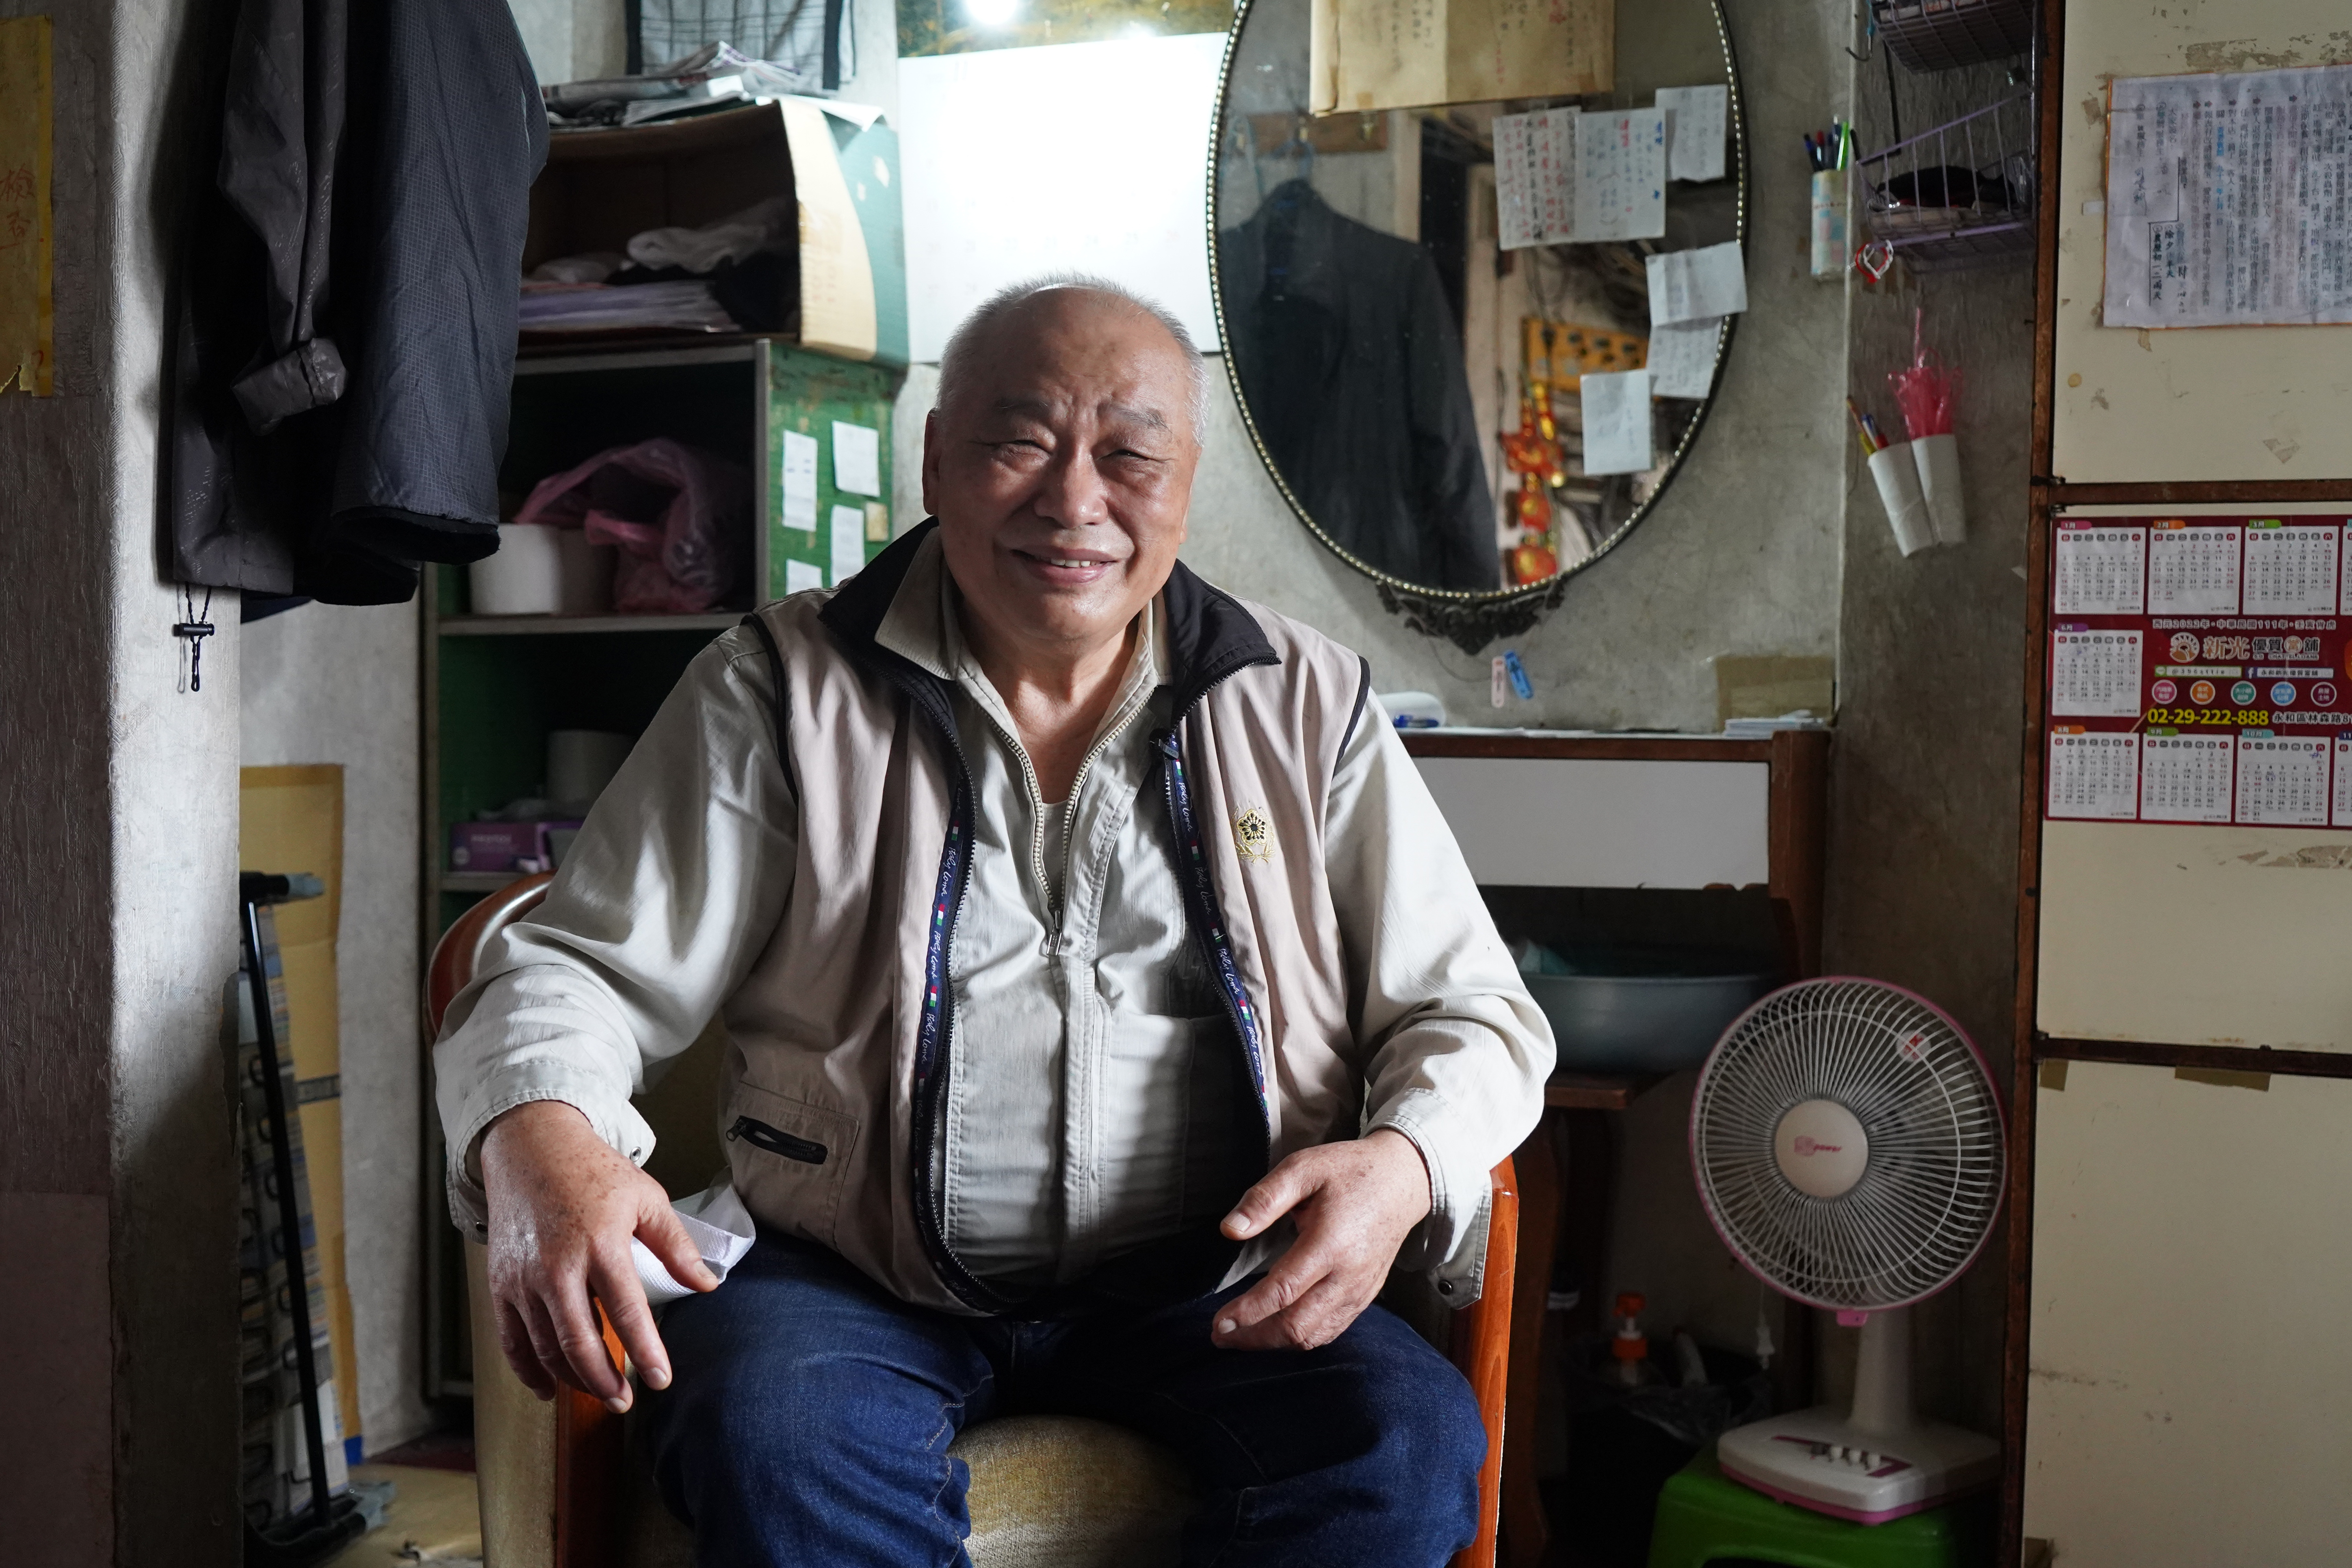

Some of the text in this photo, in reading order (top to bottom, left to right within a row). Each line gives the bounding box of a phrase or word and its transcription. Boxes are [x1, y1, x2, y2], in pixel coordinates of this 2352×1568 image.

[2203, 636, 2250, 660] 新光
[2147, 708, 2269, 726] 02-29-222-888
[1178, 782, 1189, 805] Italy
[943, 847, 956, 869] Italy
[1195, 867, 1207, 888] Italy
[1217, 948, 1232, 970] Italy
[922, 1013, 936, 1036] Italy
